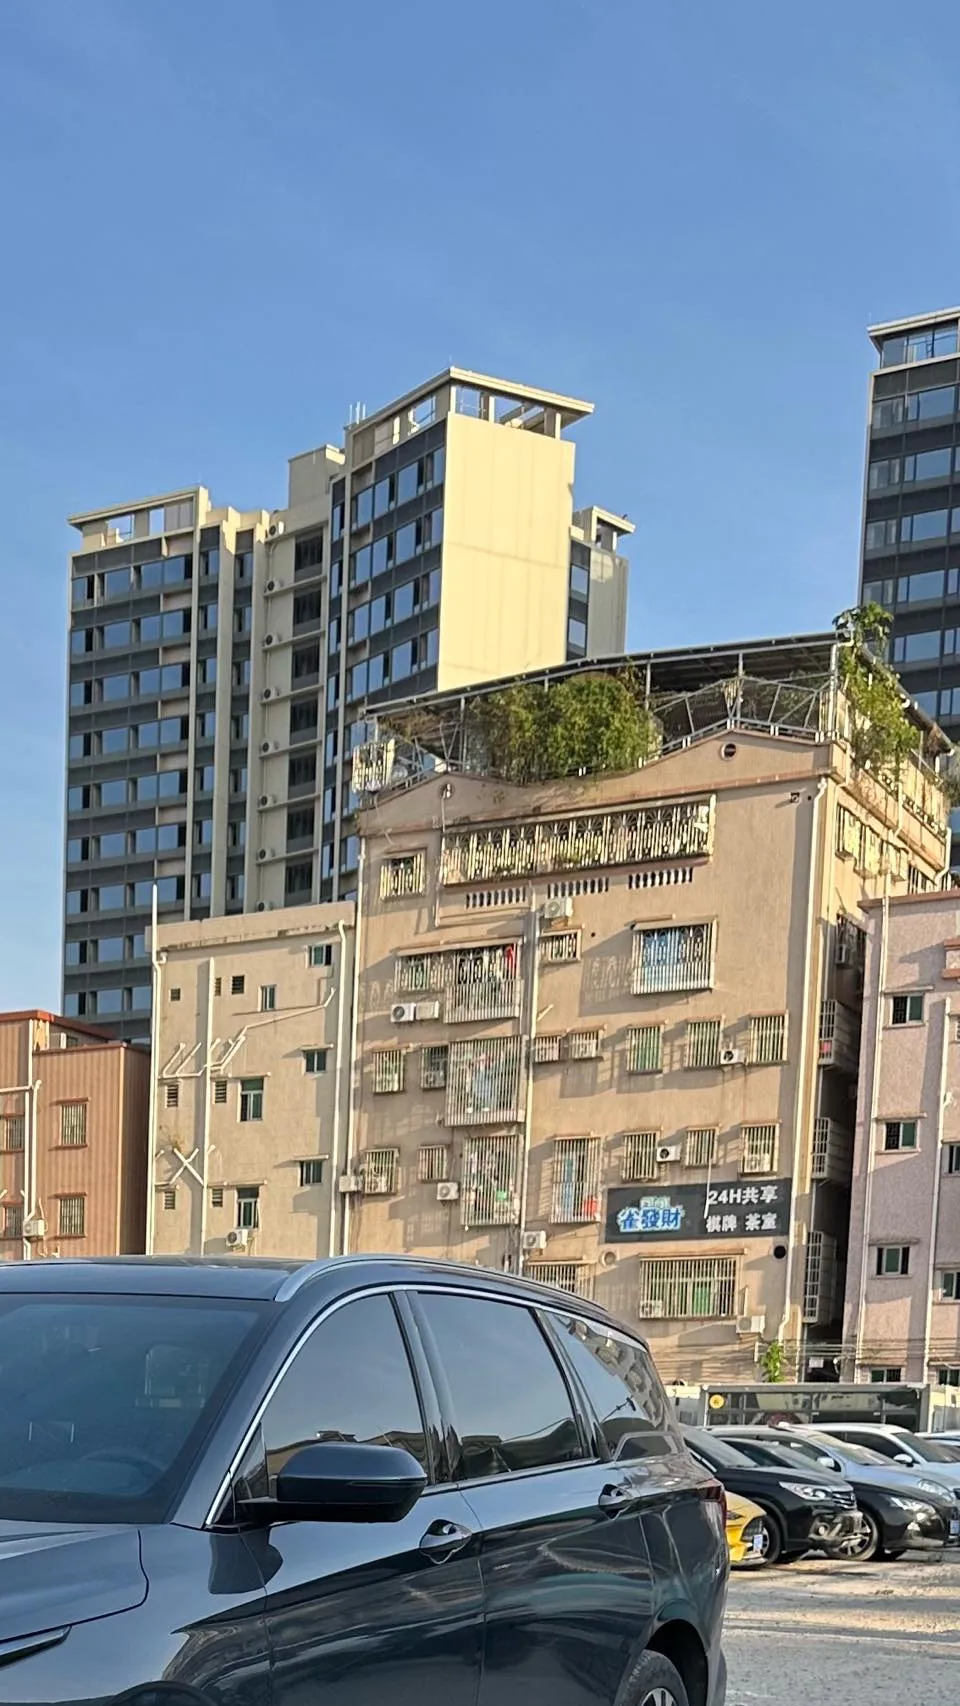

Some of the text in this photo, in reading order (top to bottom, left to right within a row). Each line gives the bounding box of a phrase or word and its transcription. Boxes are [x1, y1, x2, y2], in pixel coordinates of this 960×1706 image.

[708, 1185, 778, 1205] 24H共享
[706, 1212, 777, 1232] 棋牌 茶室
